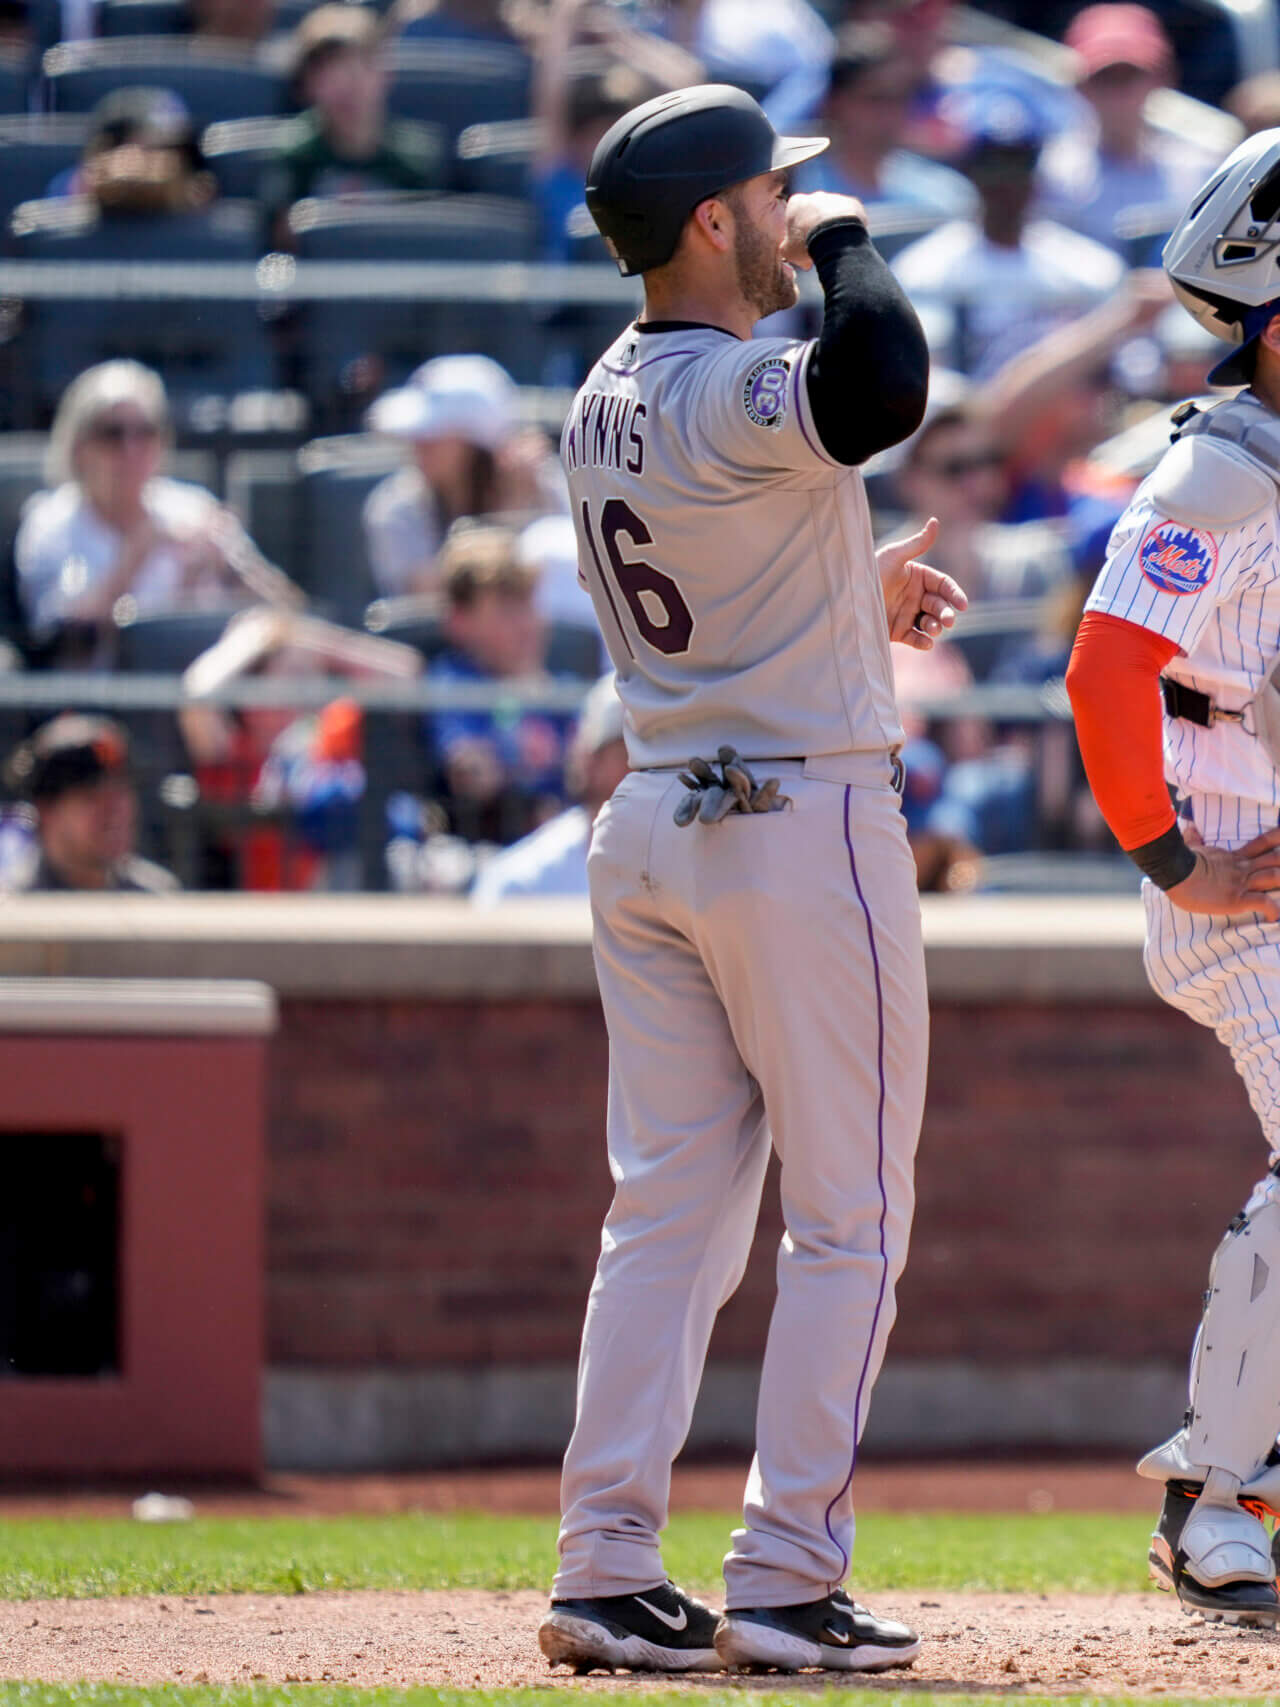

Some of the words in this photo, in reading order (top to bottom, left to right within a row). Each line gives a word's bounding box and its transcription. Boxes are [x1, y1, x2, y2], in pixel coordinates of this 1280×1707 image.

[755, 371, 783, 412] 30
[581, 497, 696, 661] 16
[1148, 544, 1204, 581] Mets
